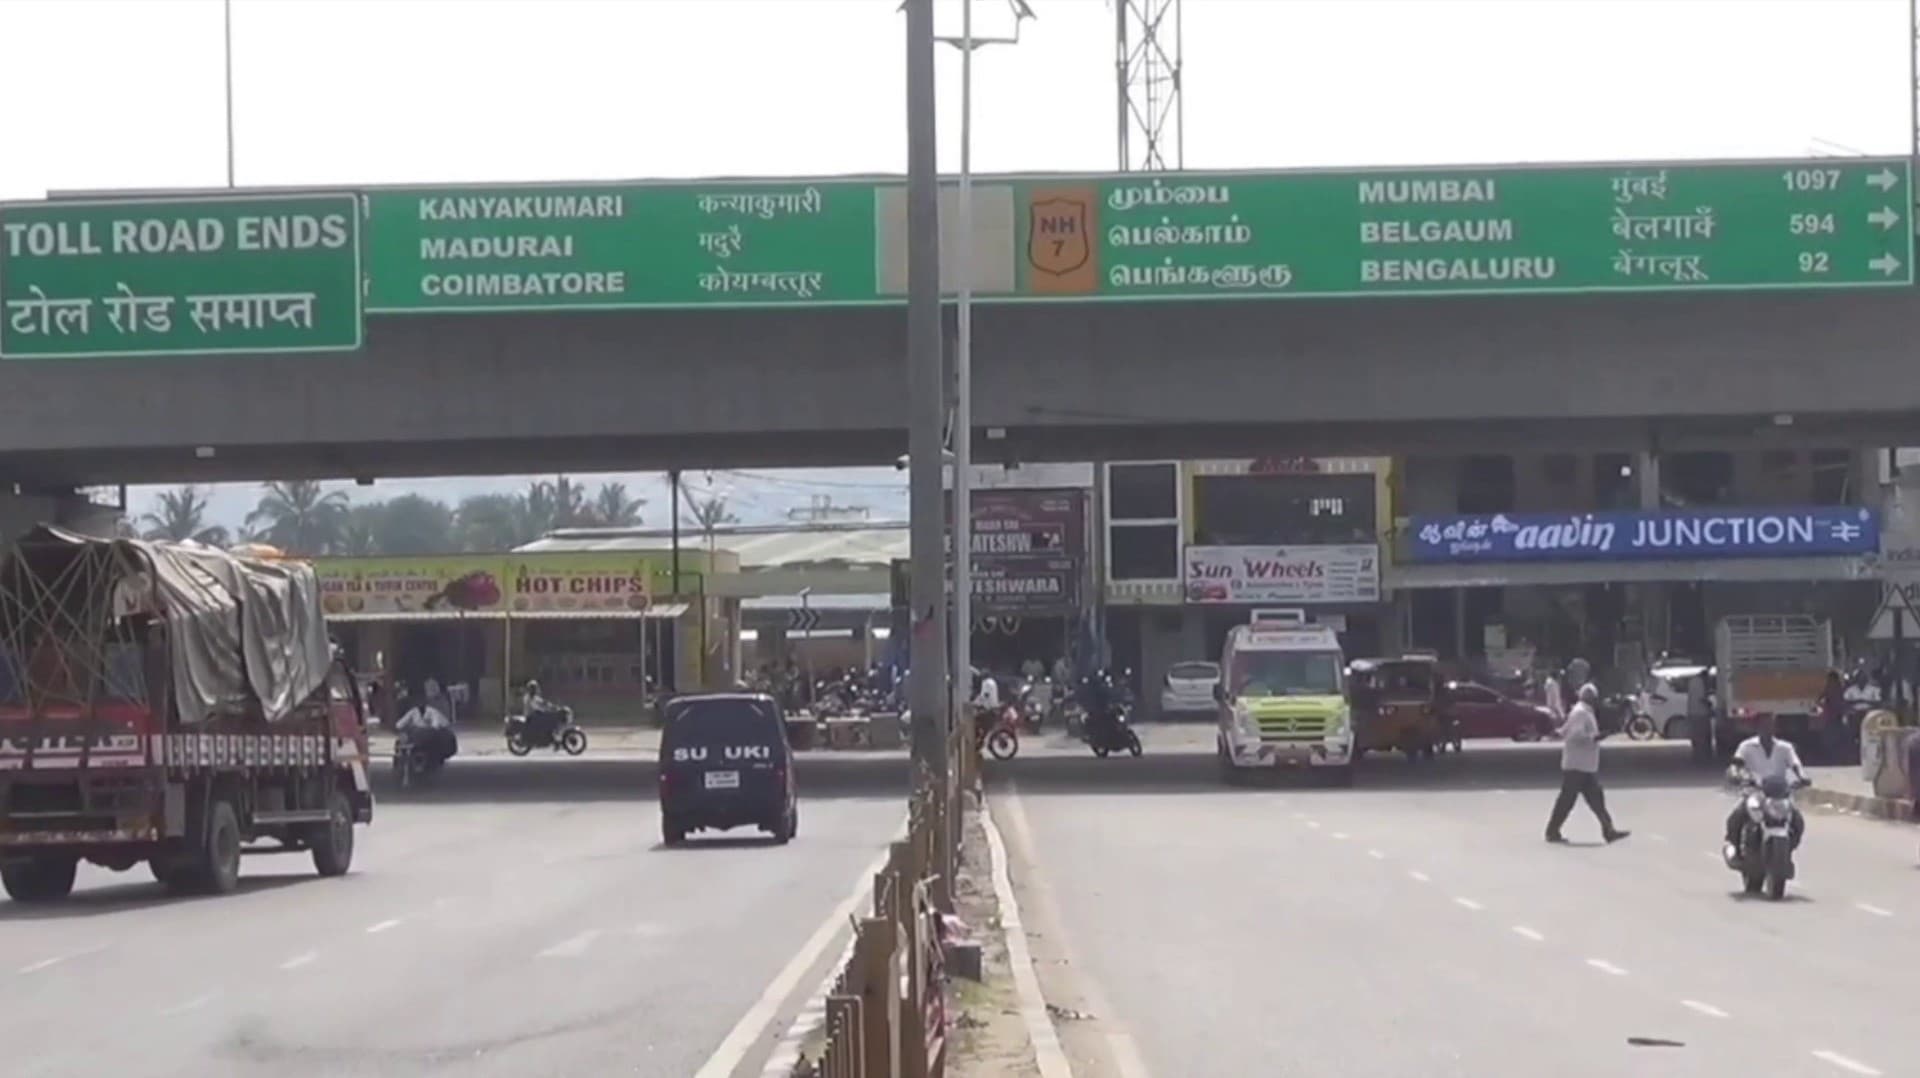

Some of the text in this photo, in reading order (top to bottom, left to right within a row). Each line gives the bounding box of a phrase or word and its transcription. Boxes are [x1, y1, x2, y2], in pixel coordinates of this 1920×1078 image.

[1358, 180, 1495, 203] MUMBAI
[1782, 169, 1841, 191] 1097
[1108, 179, 1229, 210] மும்பை
[419, 195, 623, 221] KANYAKUMARI
[4, 214, 347, 256] TOLL ROAD ENDS
[1040, 216, 1075, 233] NH
[1108, 214, 1251, 246] பெல்காம்
[1360, 219, 1513, 243] BELGAUM
[1789, 213, 1835, 234] 594
[420, 234, 573, 260] MADURAI
[1052, 240, 1065, 256] 7
[1361, 257, 1555, 282] BENGALURU
[1799, 252, 1829, 272] 92
[421, 271, 625, 296] COIMBATORE
[8, 282, 316, 335] टोल रोड समाप्त
[1632, 516, 1814, 546] JUNCTION
[1190, 561, 1233, 579] Sun
[1243, 555, 1325, 579] Wheels
[516, 576, 643, 593] HOT CHIPS
